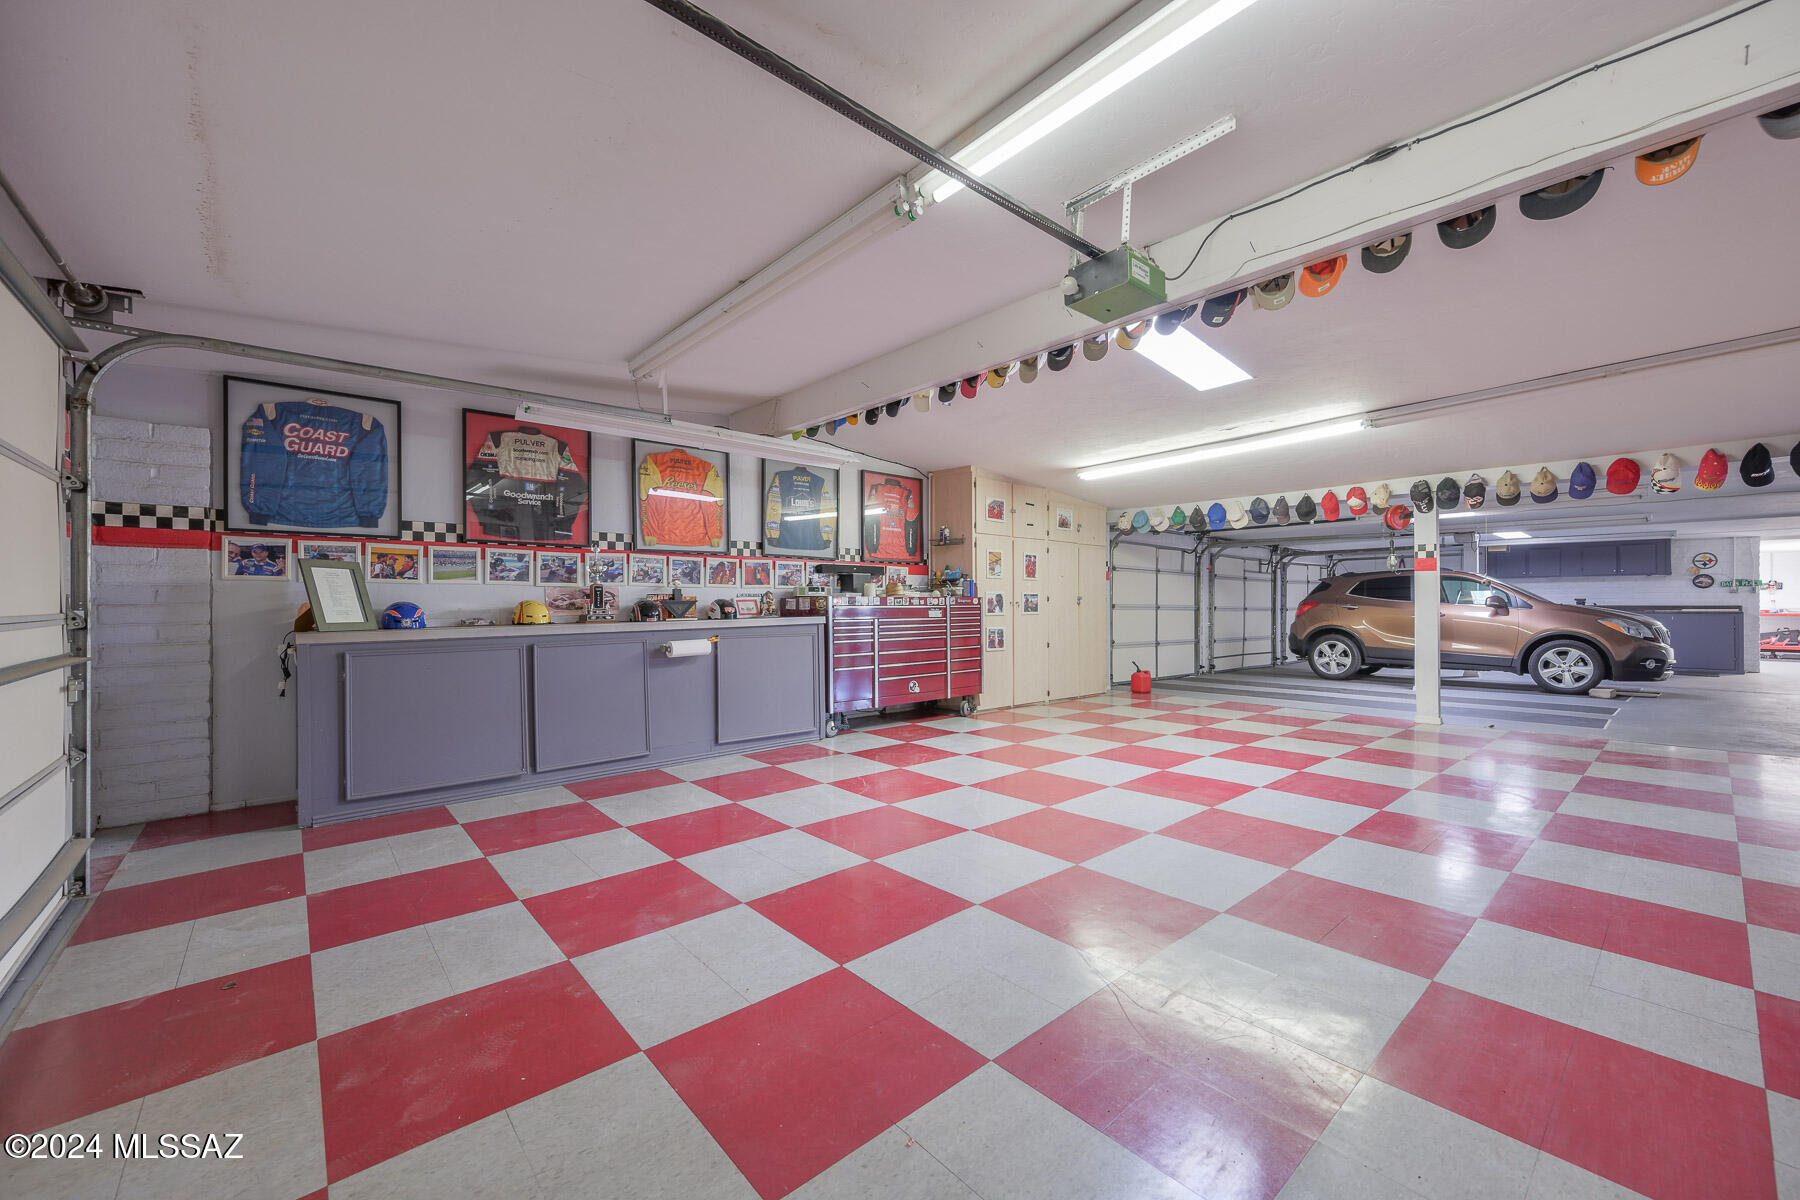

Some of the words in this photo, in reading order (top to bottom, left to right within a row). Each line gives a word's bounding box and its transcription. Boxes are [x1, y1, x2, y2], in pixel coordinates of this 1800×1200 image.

[283, 422, 351, 443] COAST
[283, 437, 351, 458] GUARD
[514, 438, 546, 448] PULVER
[503, 489, 554, 501] Goodwrench
[517, 498, 542, 506] Service
